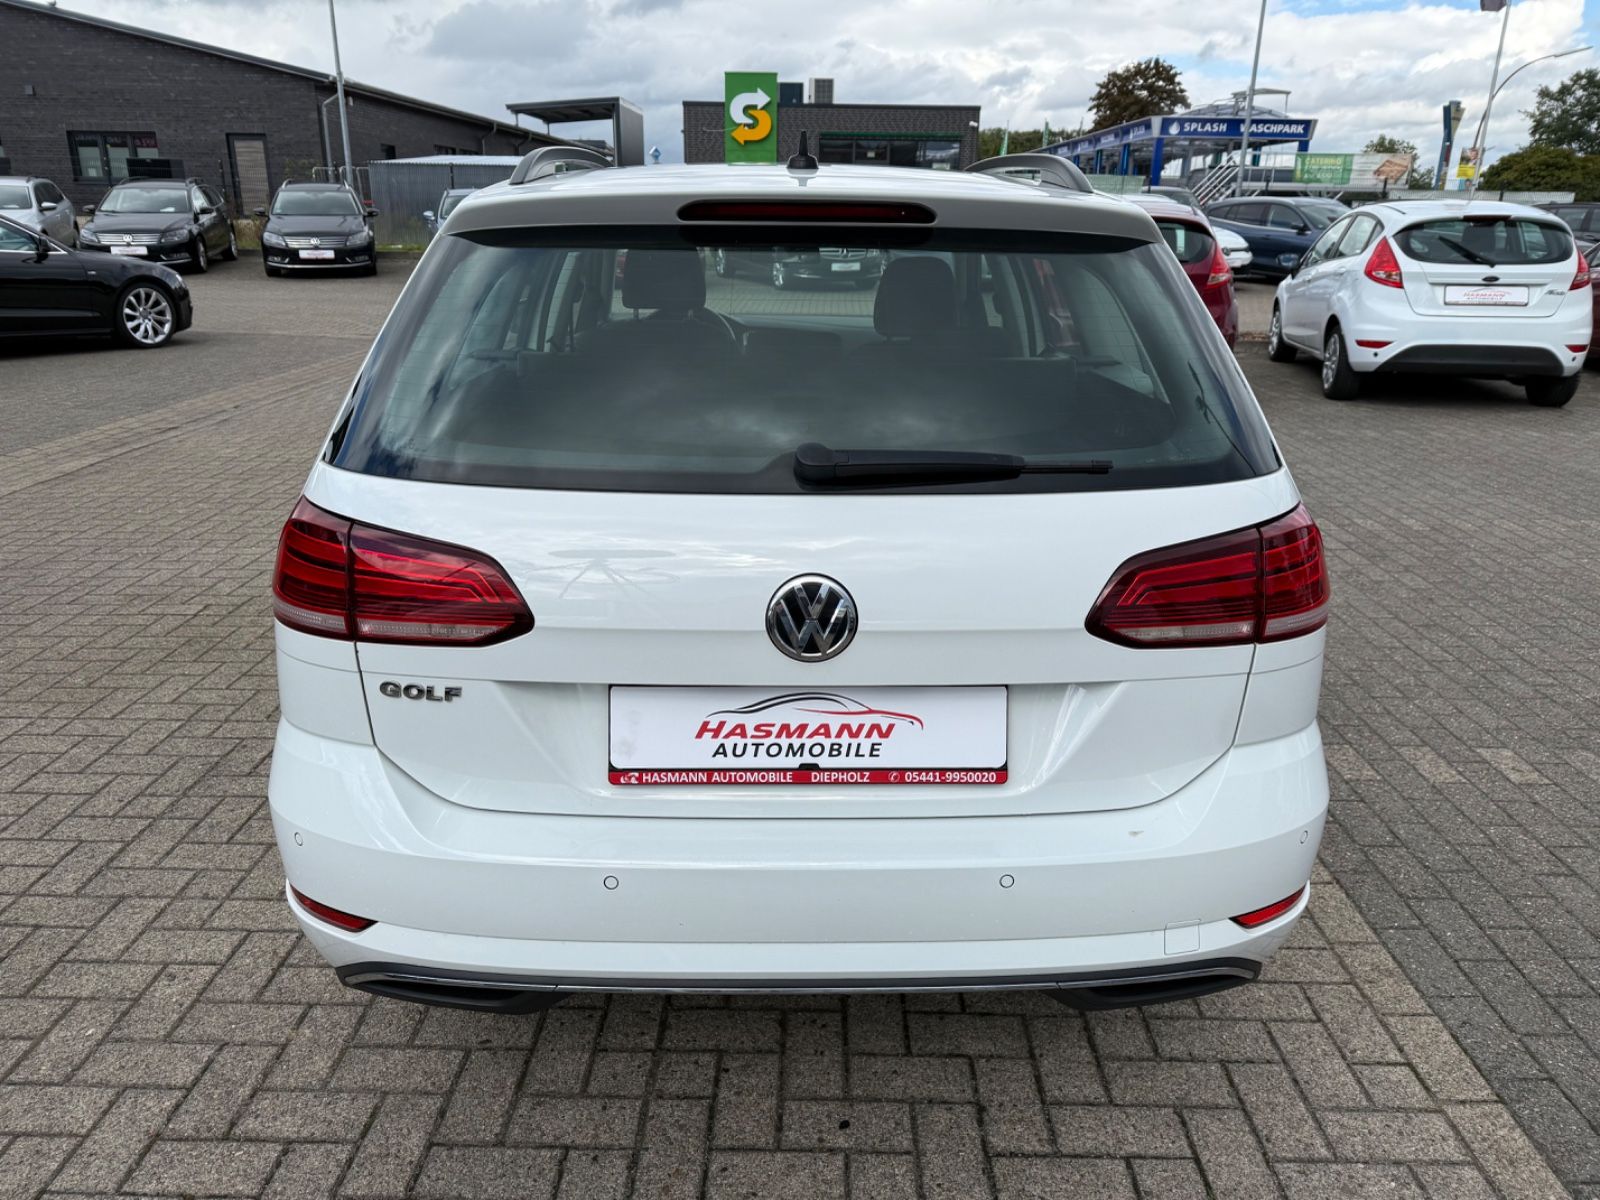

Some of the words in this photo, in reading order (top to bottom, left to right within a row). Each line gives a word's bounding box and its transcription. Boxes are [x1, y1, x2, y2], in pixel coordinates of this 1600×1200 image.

[1183, 122, 1228, 132] SPLASH
[379, 681, 462, 702] GOLF
[695, 720, 895, 739] HASMANN
[711, 742, 882, 758] AUTOMOBILE
[642, 772, 707, 783] HASMANN
[711, 772, 793, 783] AUTOMOBILE
[811, 772, 870, 783] DIEPHOLZ
[904, 771, 996, 783] 05441-9950020
